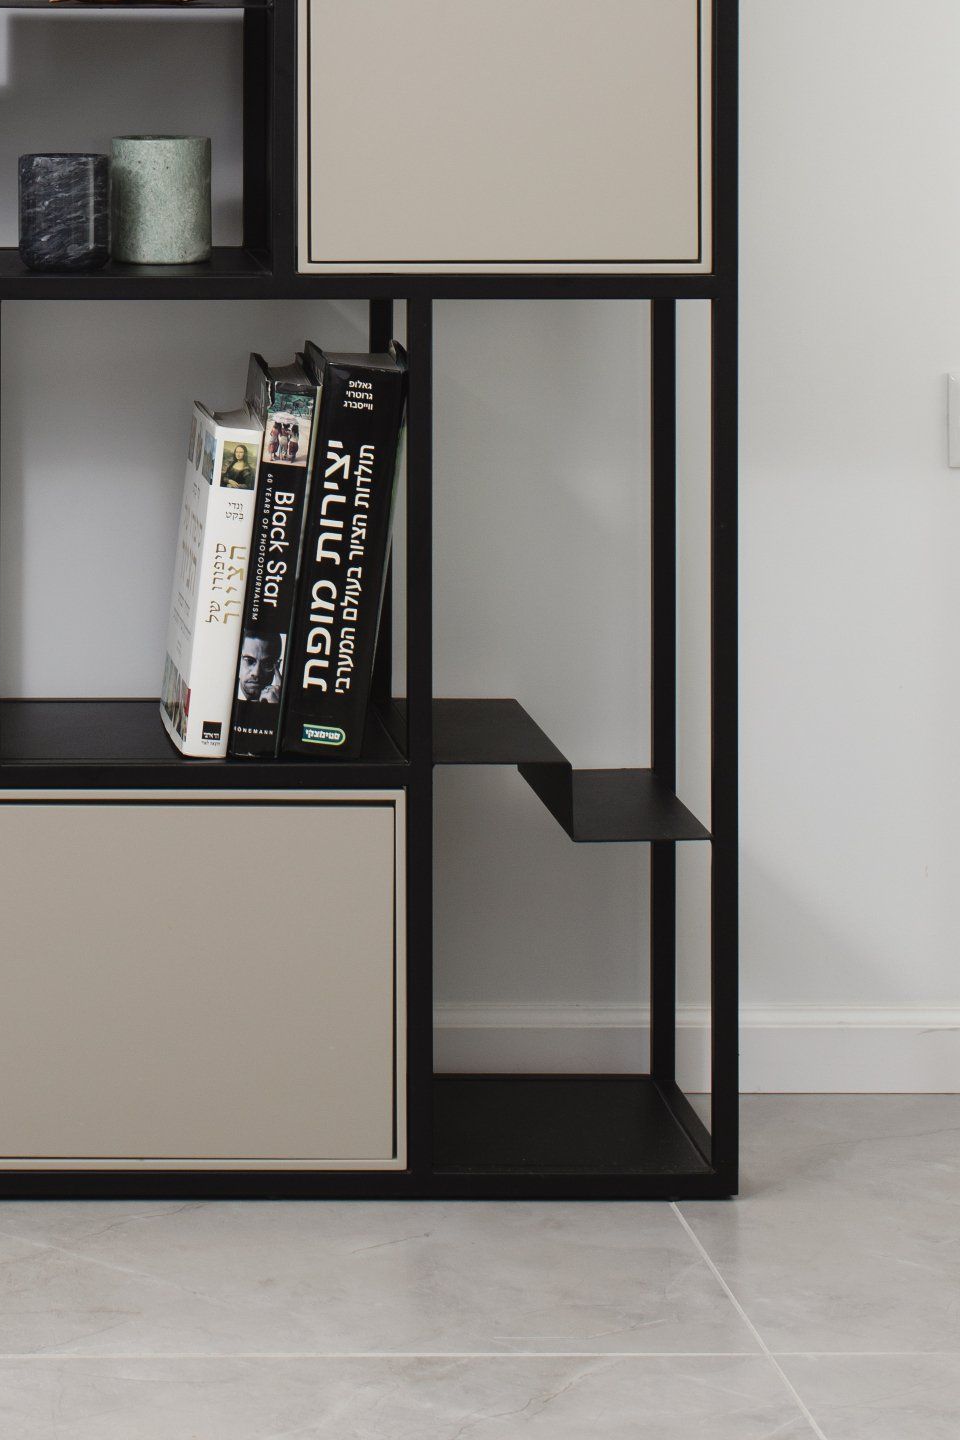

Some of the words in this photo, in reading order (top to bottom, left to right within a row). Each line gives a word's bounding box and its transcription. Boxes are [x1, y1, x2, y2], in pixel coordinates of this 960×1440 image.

[349, 379, 373, 390] גאלופ
[263, 487, 273, 514] YEARS
[266, 473, 274, 483] 60
[315, 439, 351, 566] יצירות
[353, 443, 375, 509] תולדות
[261, 517, 270, 530] OF
[268, 490, 295, 553] Black
[349, 513, 368, 561] הציור
[211, 543, 227, 591] סיפורו
[223, 545, 247, 624] הציור
[251, 533, 268, 621] PHOTOJOURNALISM
[262, 560, 288, 608] Star
[340, 566, 363, 621] בעולם
[302, 579, 338, 693] מופת
[335, 627, 356, 694] המערבי
